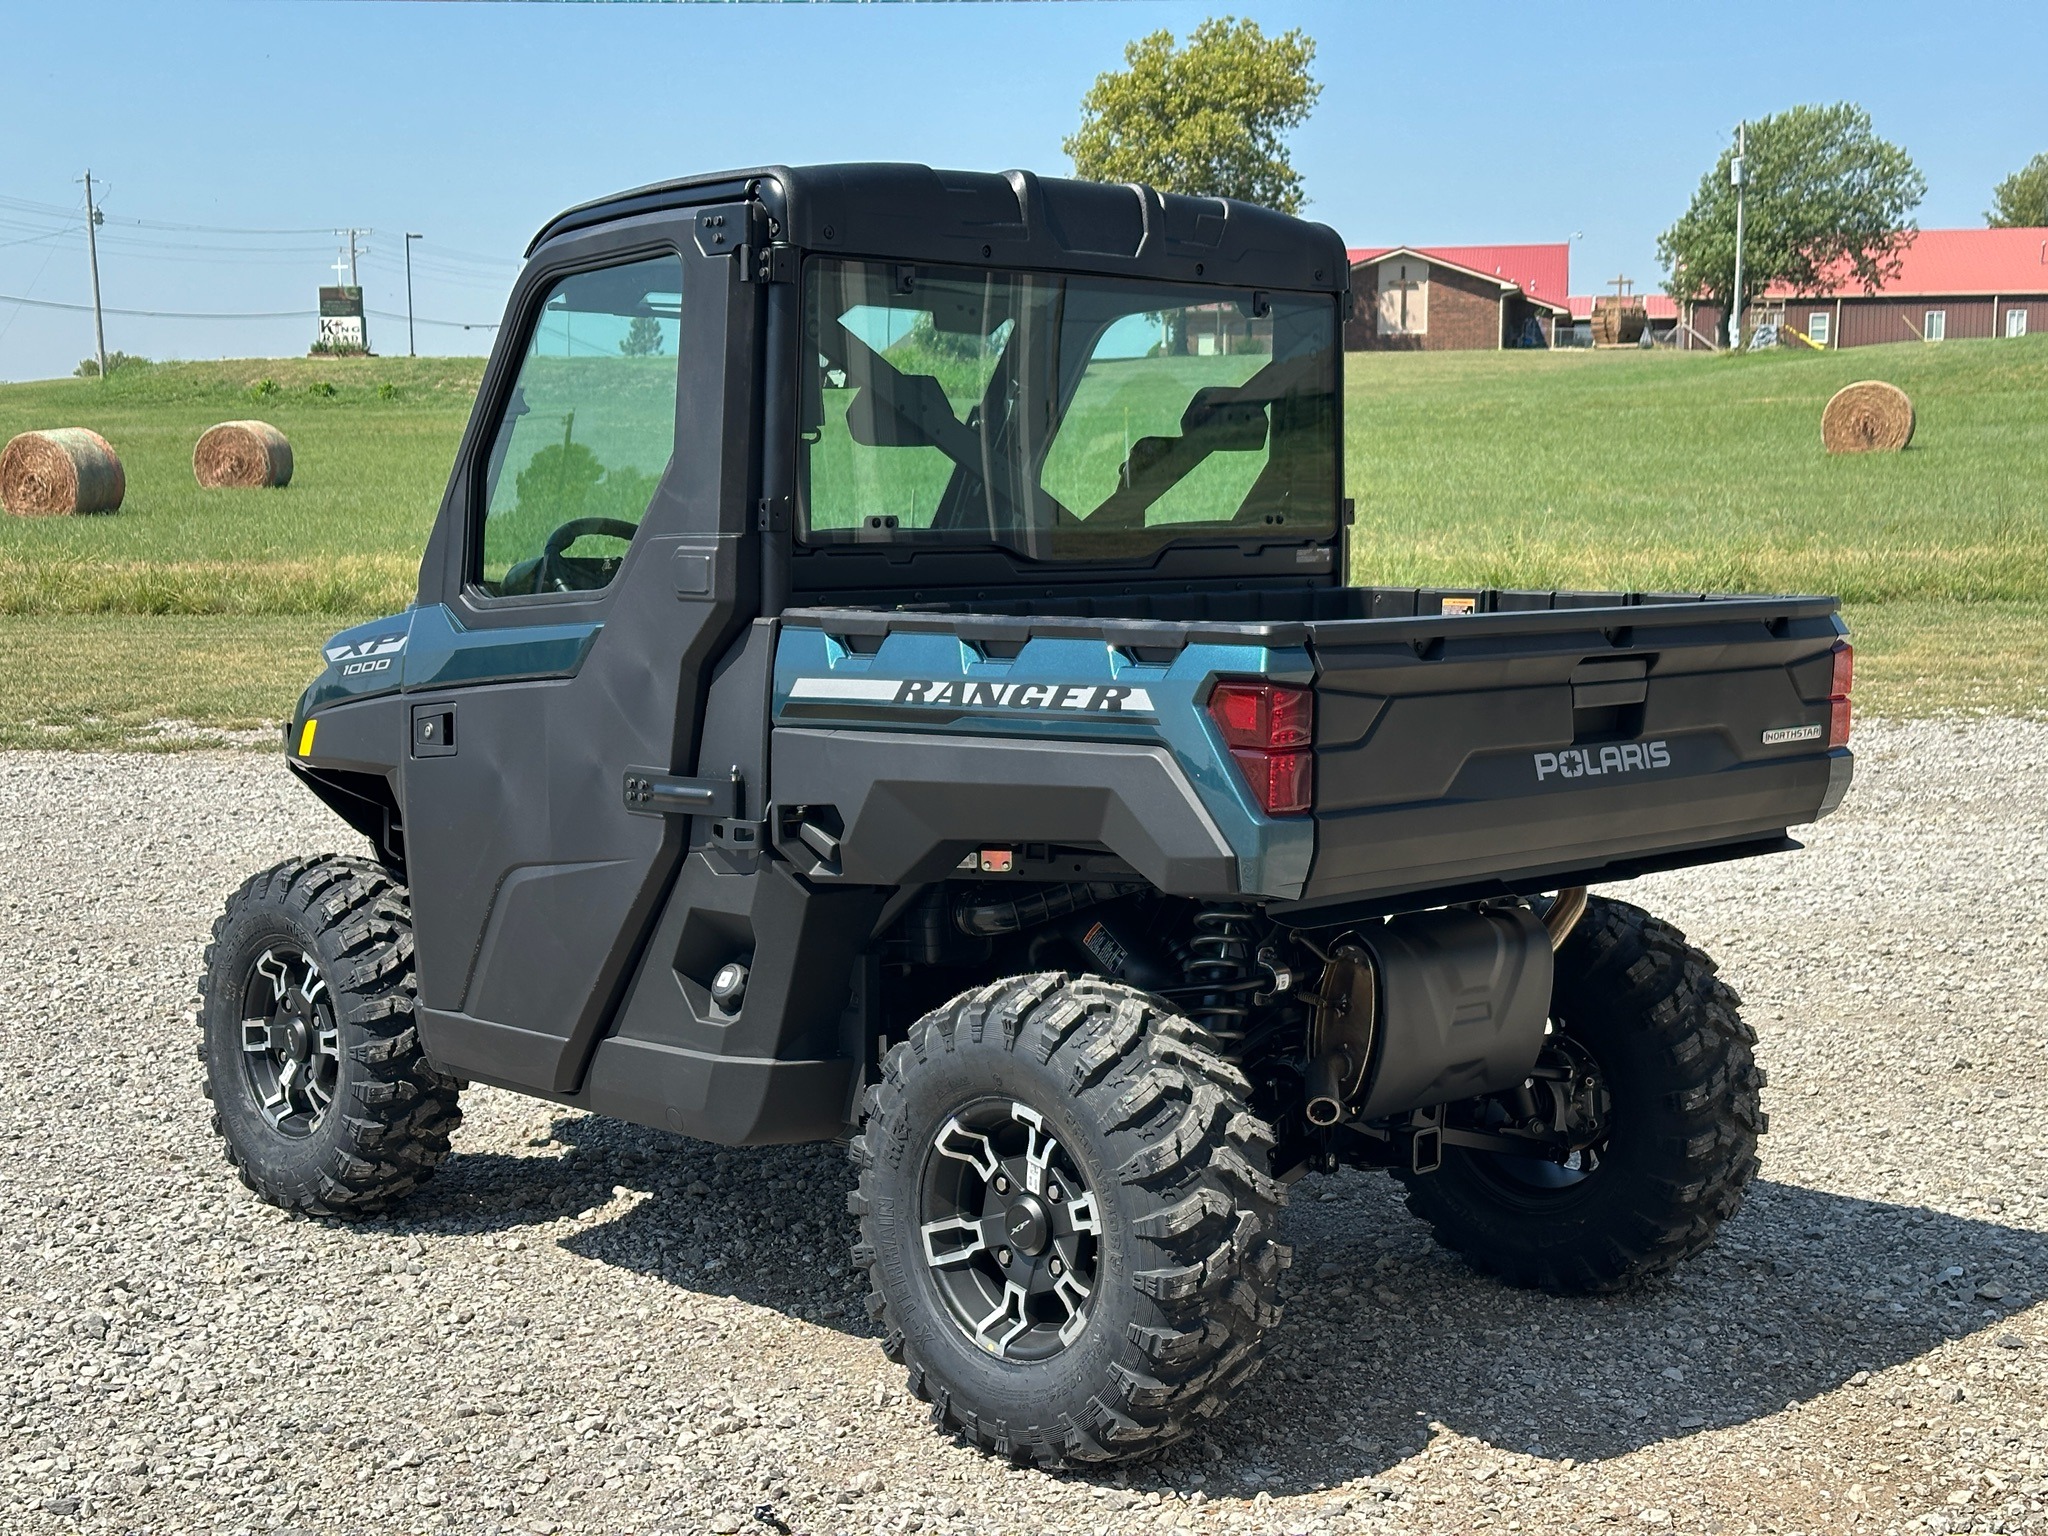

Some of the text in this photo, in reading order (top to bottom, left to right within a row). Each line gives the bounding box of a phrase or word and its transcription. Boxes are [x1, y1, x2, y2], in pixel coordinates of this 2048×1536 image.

[333, 631, 407, 660] XP
[343, 658, 391, 676] 1000
[891, 678, 1133, 713] RANGER
[1766, 726, 1821, 743] NORTHSTAR
[1533, 740, 1671, 781] POLARIS
